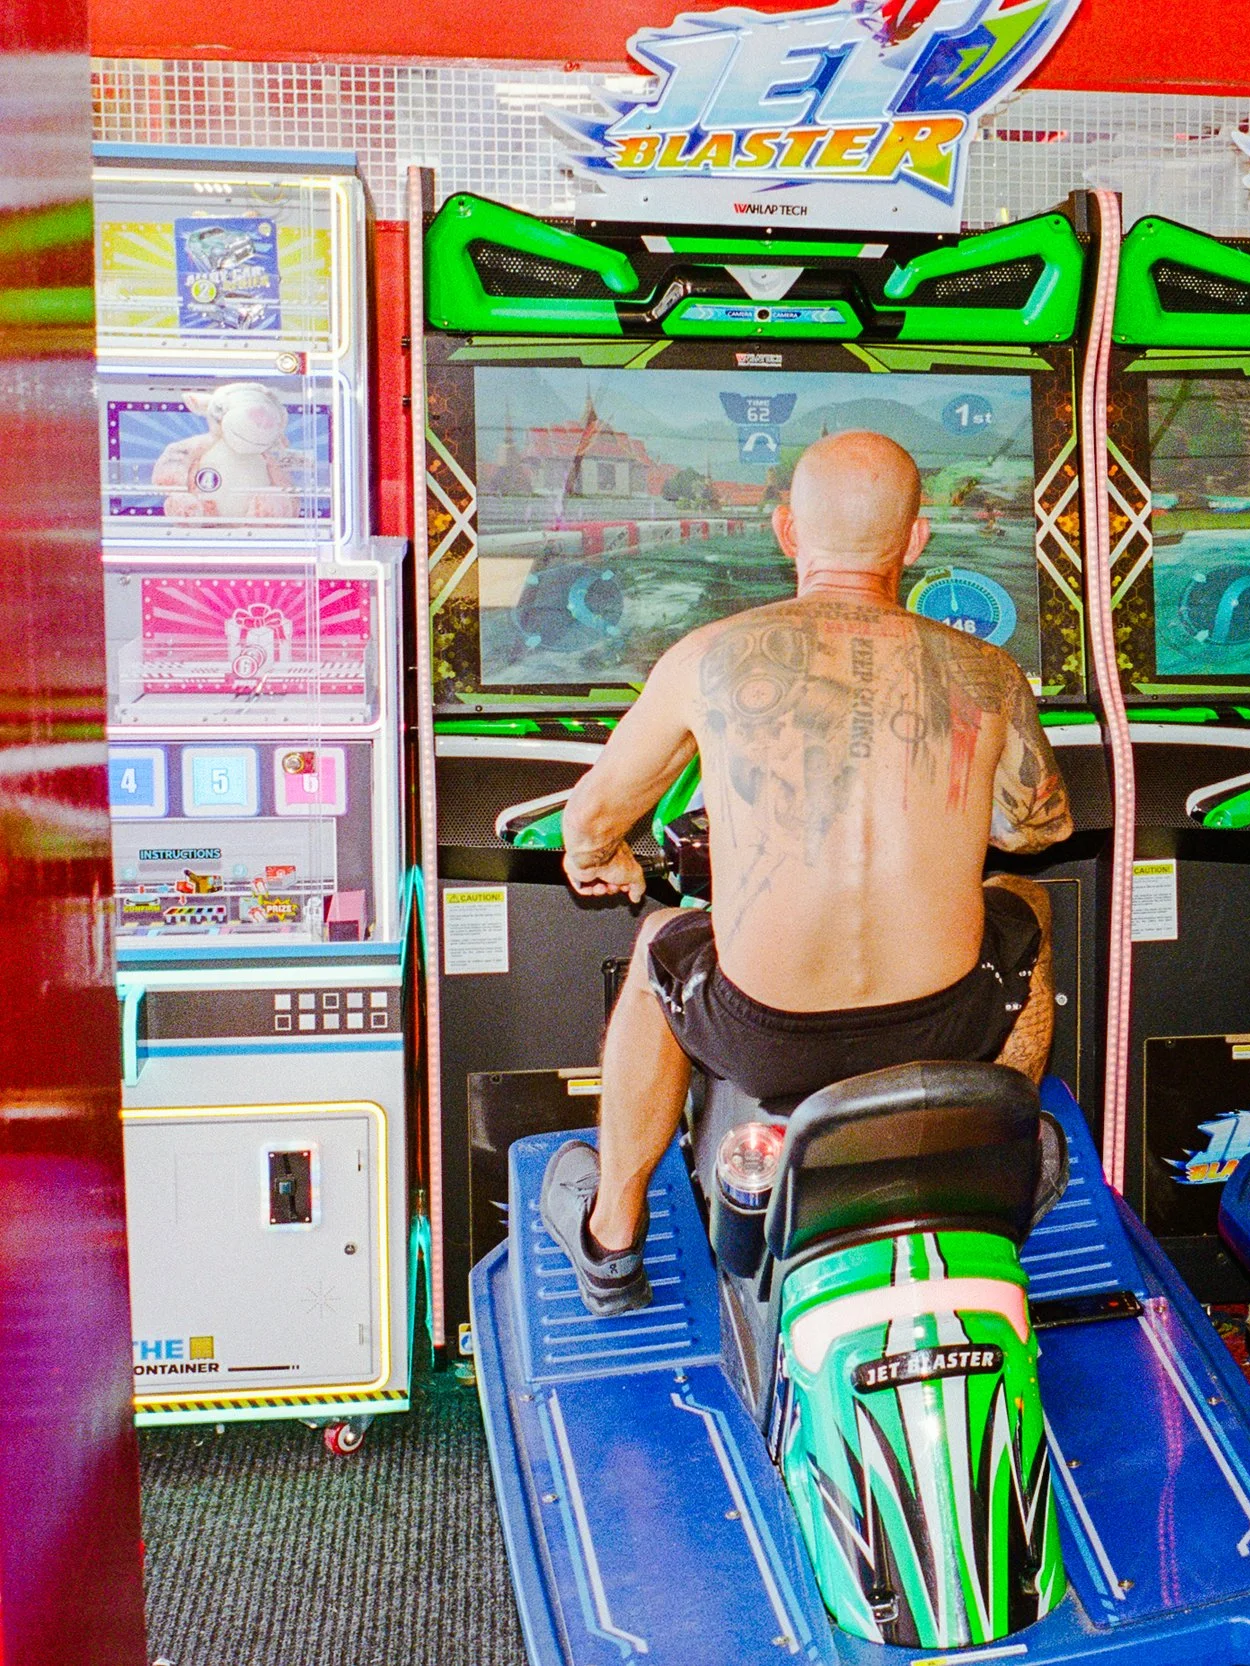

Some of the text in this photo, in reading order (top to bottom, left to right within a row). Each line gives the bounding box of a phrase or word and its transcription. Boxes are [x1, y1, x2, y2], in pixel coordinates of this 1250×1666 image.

[607, 0, 985, 132] JET
[616, 117, 966, 192] BLASTER
[734, 203, 808, 216] WAHLAP TECH
[747, 407, 770, 422] 62
[955, 403, 992, 427] 1st
[120, 768, 137, 793] 4
[212, 768, 229, 794] 5
[139, 848, 221, 860] INSTRUCTIONS
[460, 893, 501, 902] CAUTION!
[133, 1362, 220, 1376] ONTAINER
[866, 1351, 994, 1386] JET BLASTER
